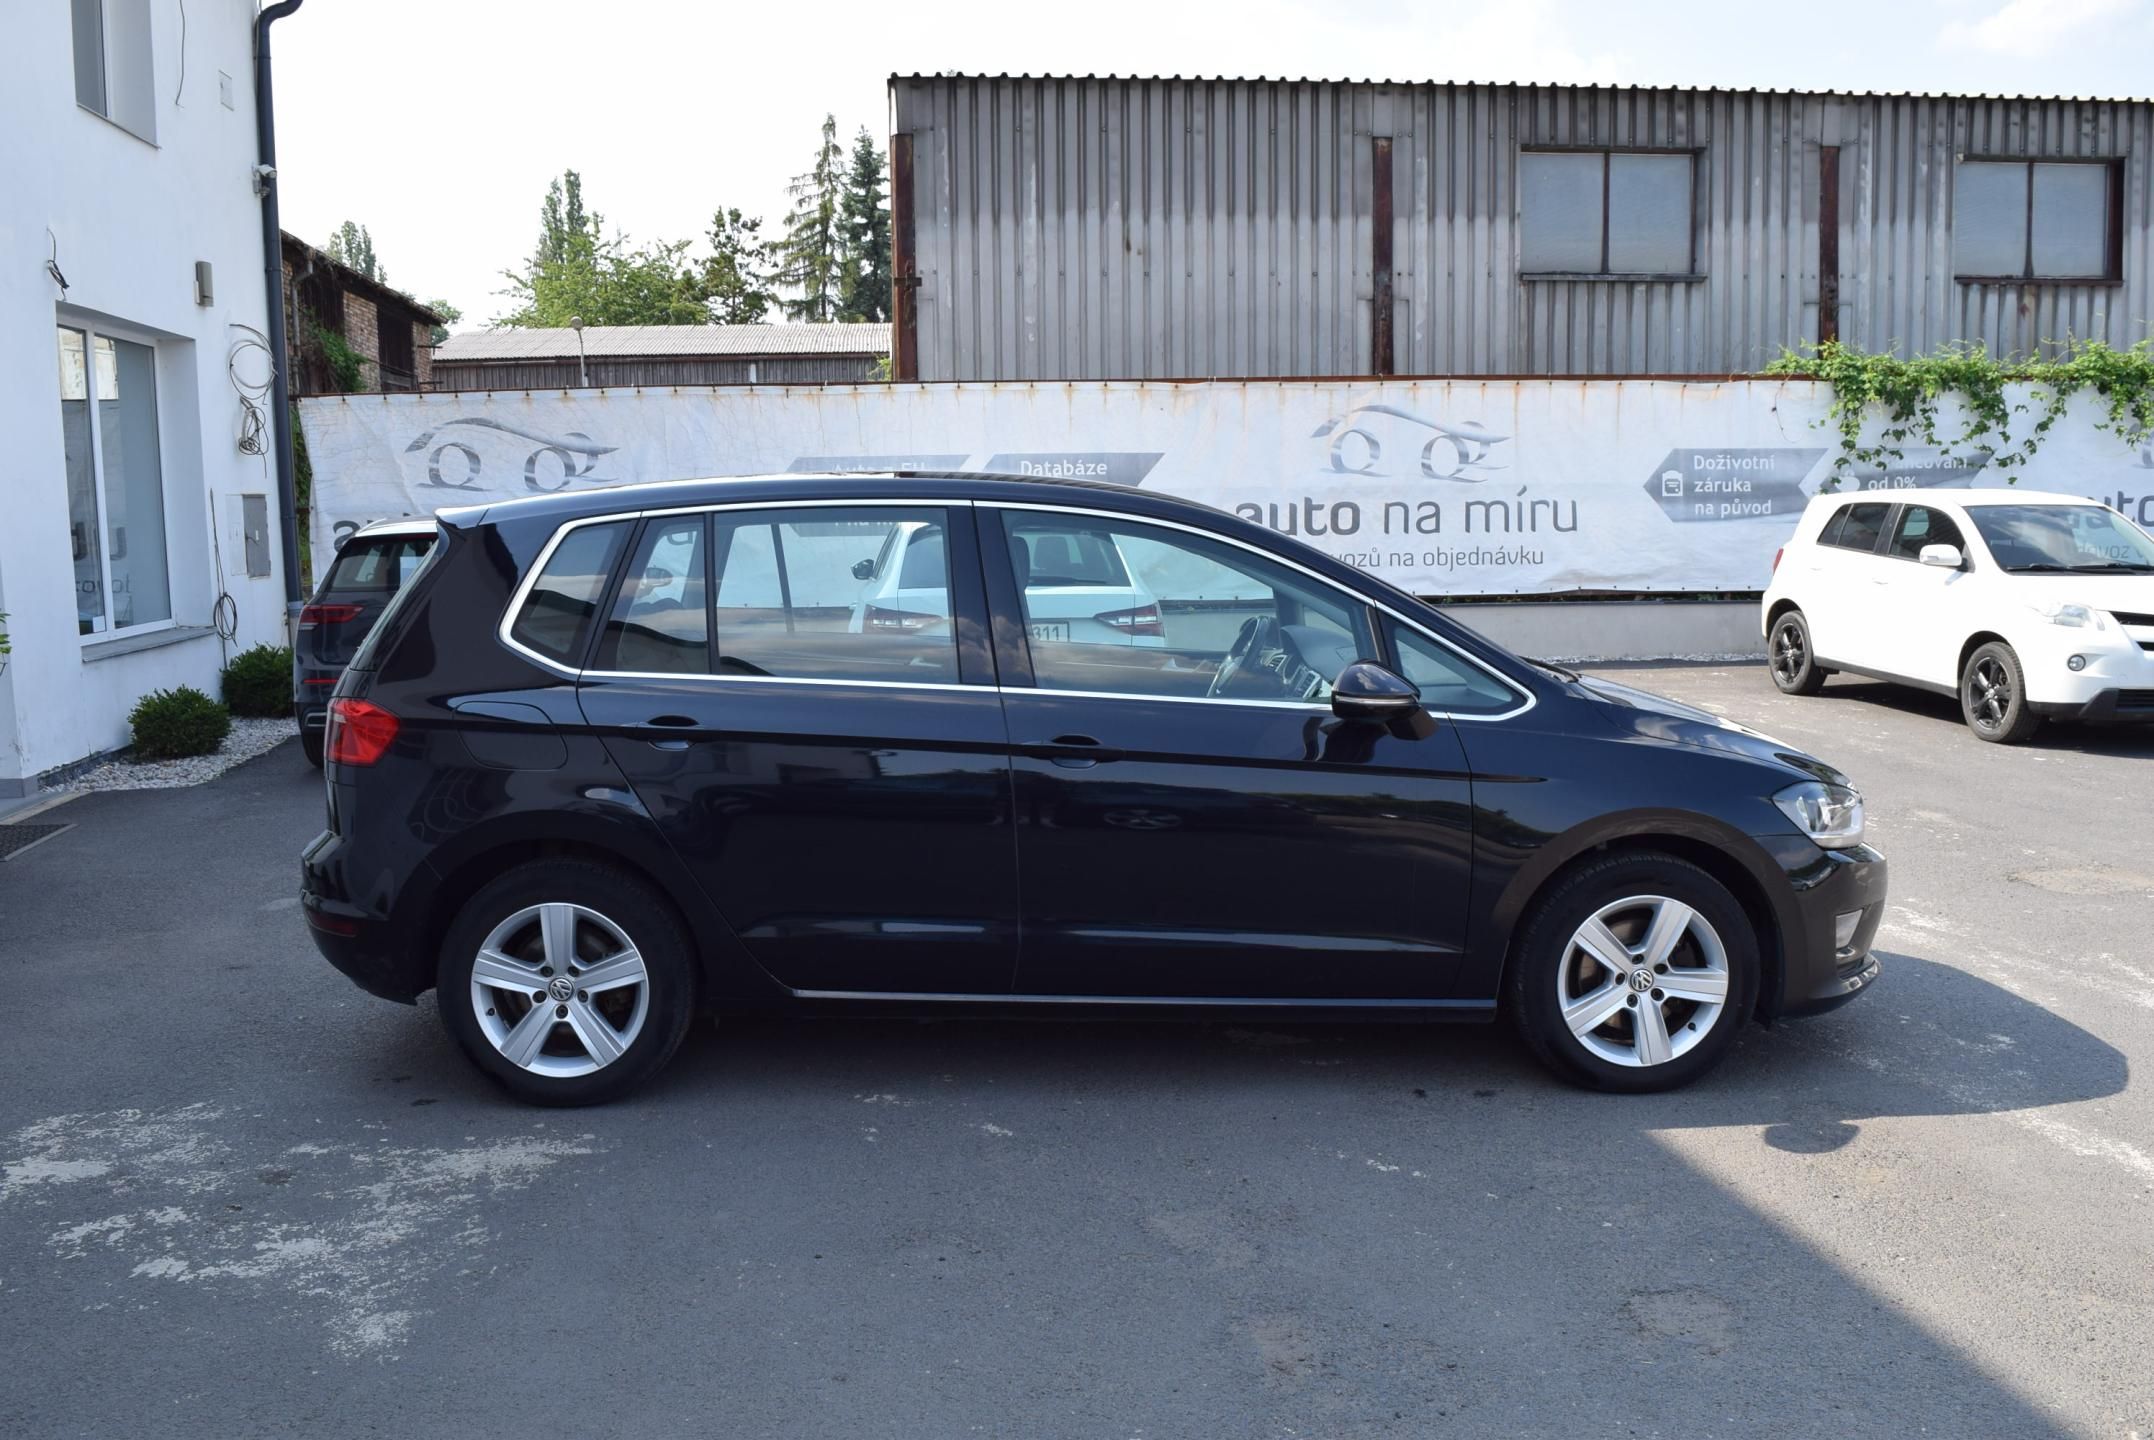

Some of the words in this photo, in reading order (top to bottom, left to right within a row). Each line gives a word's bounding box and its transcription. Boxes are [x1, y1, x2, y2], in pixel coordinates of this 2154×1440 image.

[1019, 459, 1108, 477] Databáze
[1693, 454, 1776, 471] Doživotní
[1693, 476, 1752, 493] záruka
[1867, 476, 1889, 489] od
[1235, 496, 1361, 537] auto
[1383, 500, 1441, 535] na
[1464, 484, 1578, 533] míru
[1694, 502, 1714, 515] na
[1720, 498, 1773, 519] původ
[1389, 551, 1415, 567] na
[1422, 544, 1544, 572] objednávku
